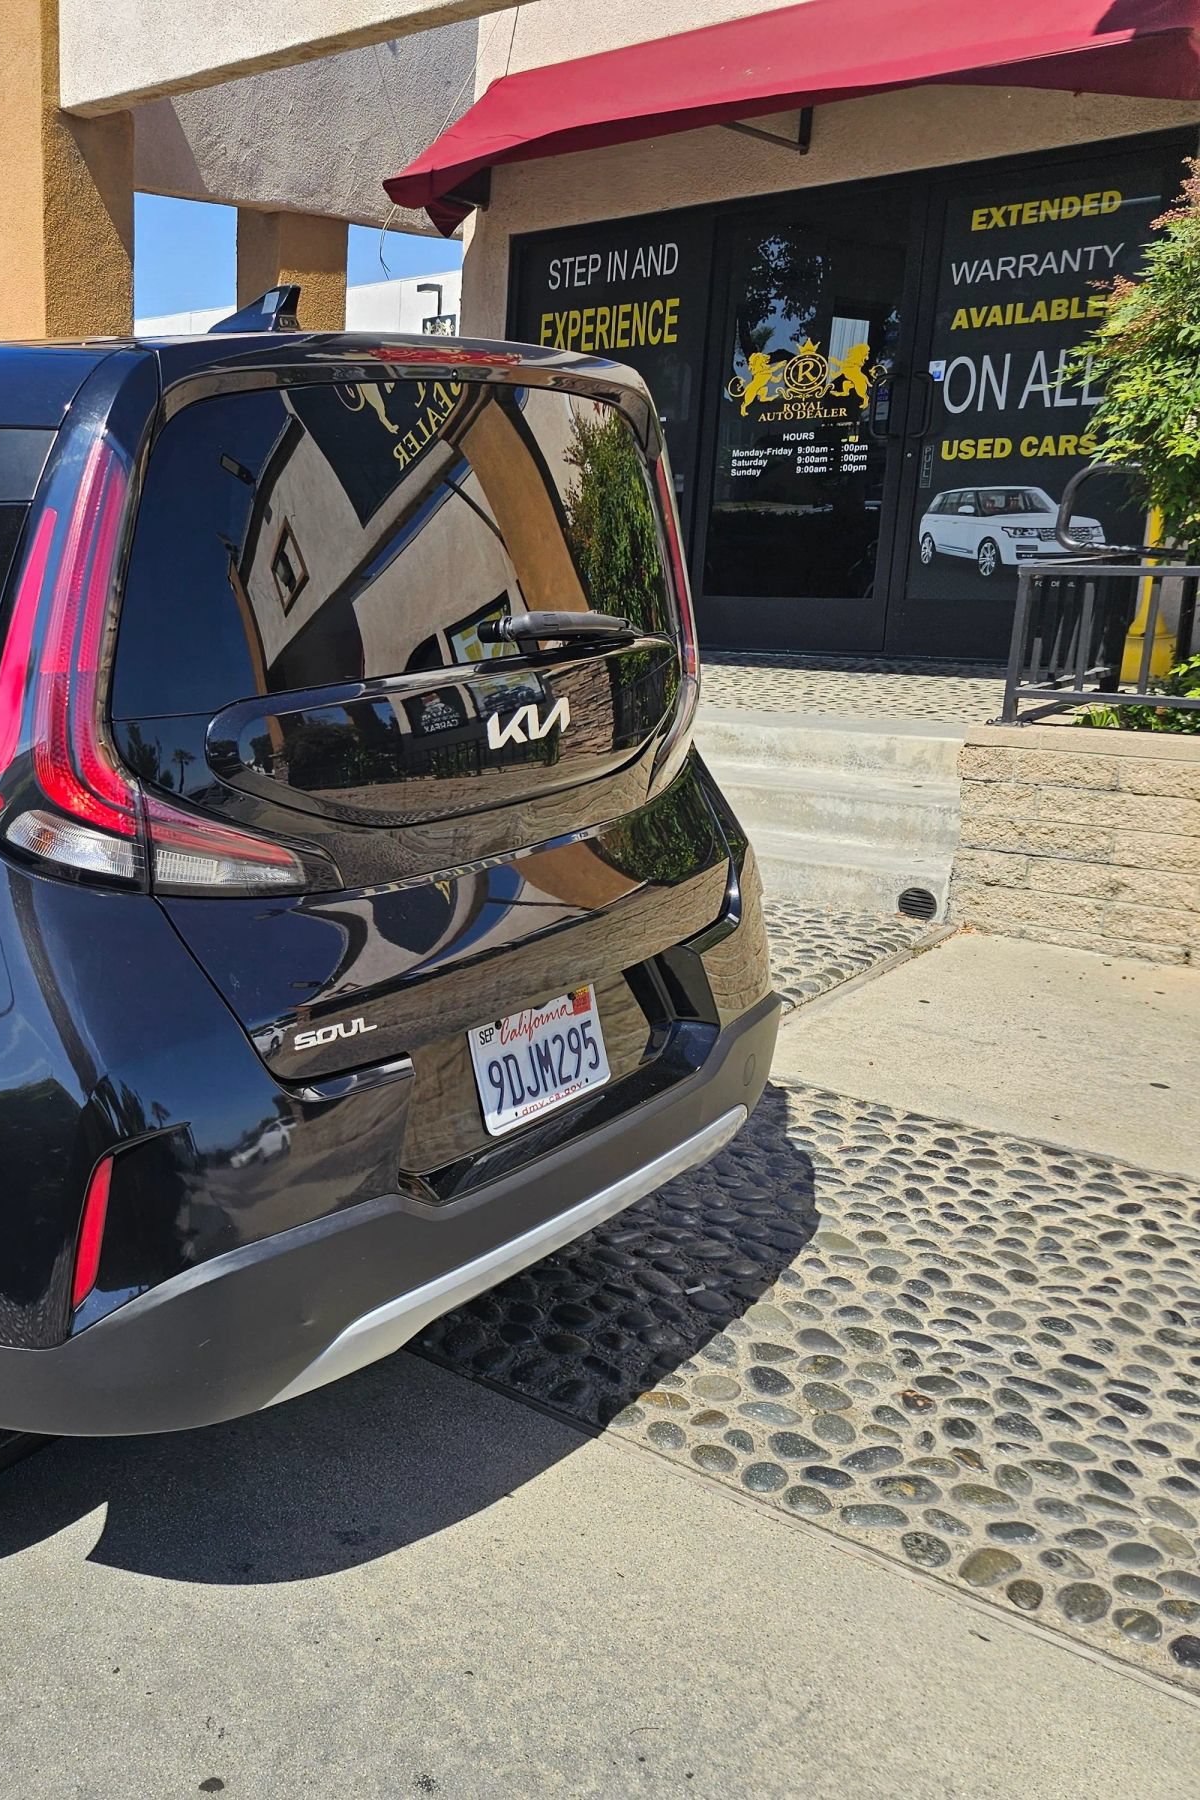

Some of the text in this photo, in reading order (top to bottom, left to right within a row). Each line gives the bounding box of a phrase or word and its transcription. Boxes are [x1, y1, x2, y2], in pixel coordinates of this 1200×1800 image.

[971, 190, 1122, 231] EXTENDED
[548, 242, 679, 290] STEP IN AND
[951, 242, 1125, 286] WARRANTY
[540, 298, 680, 352] EXPERIENCE
[797, 361, 816, 383] R
[943, 349, 1105, 414] ON ALL
[758, 408, 848, 422] AUTO DEALER
[783, 402, 824, 412] ROYAL
[732, 447, 793, 458] Monday-Friday
[797, 446, 828, 454] 9:00am
[783, 432, 815, 441] HOURS
[941, 433, 1100, 461] USED CARS
[730, 468, 761, 477] Sunday
[796, 465, 827, 474] 9:00am
[731, 459, 768, 468] Saturday
[796, 456, 828, 464] 9:00am
[922, 447, 932, 478] PULL
[487, 697, 571, 750] KIA
[294, 1017, 378, 1051] SOUL
[479, 1027, 494, 1046] SEP
[500, 1002, 574, 1046] California
[488, 1020, 600, 1115] 9DJM295
[522, 1081, 583, 1117] dmv.ca.gov
